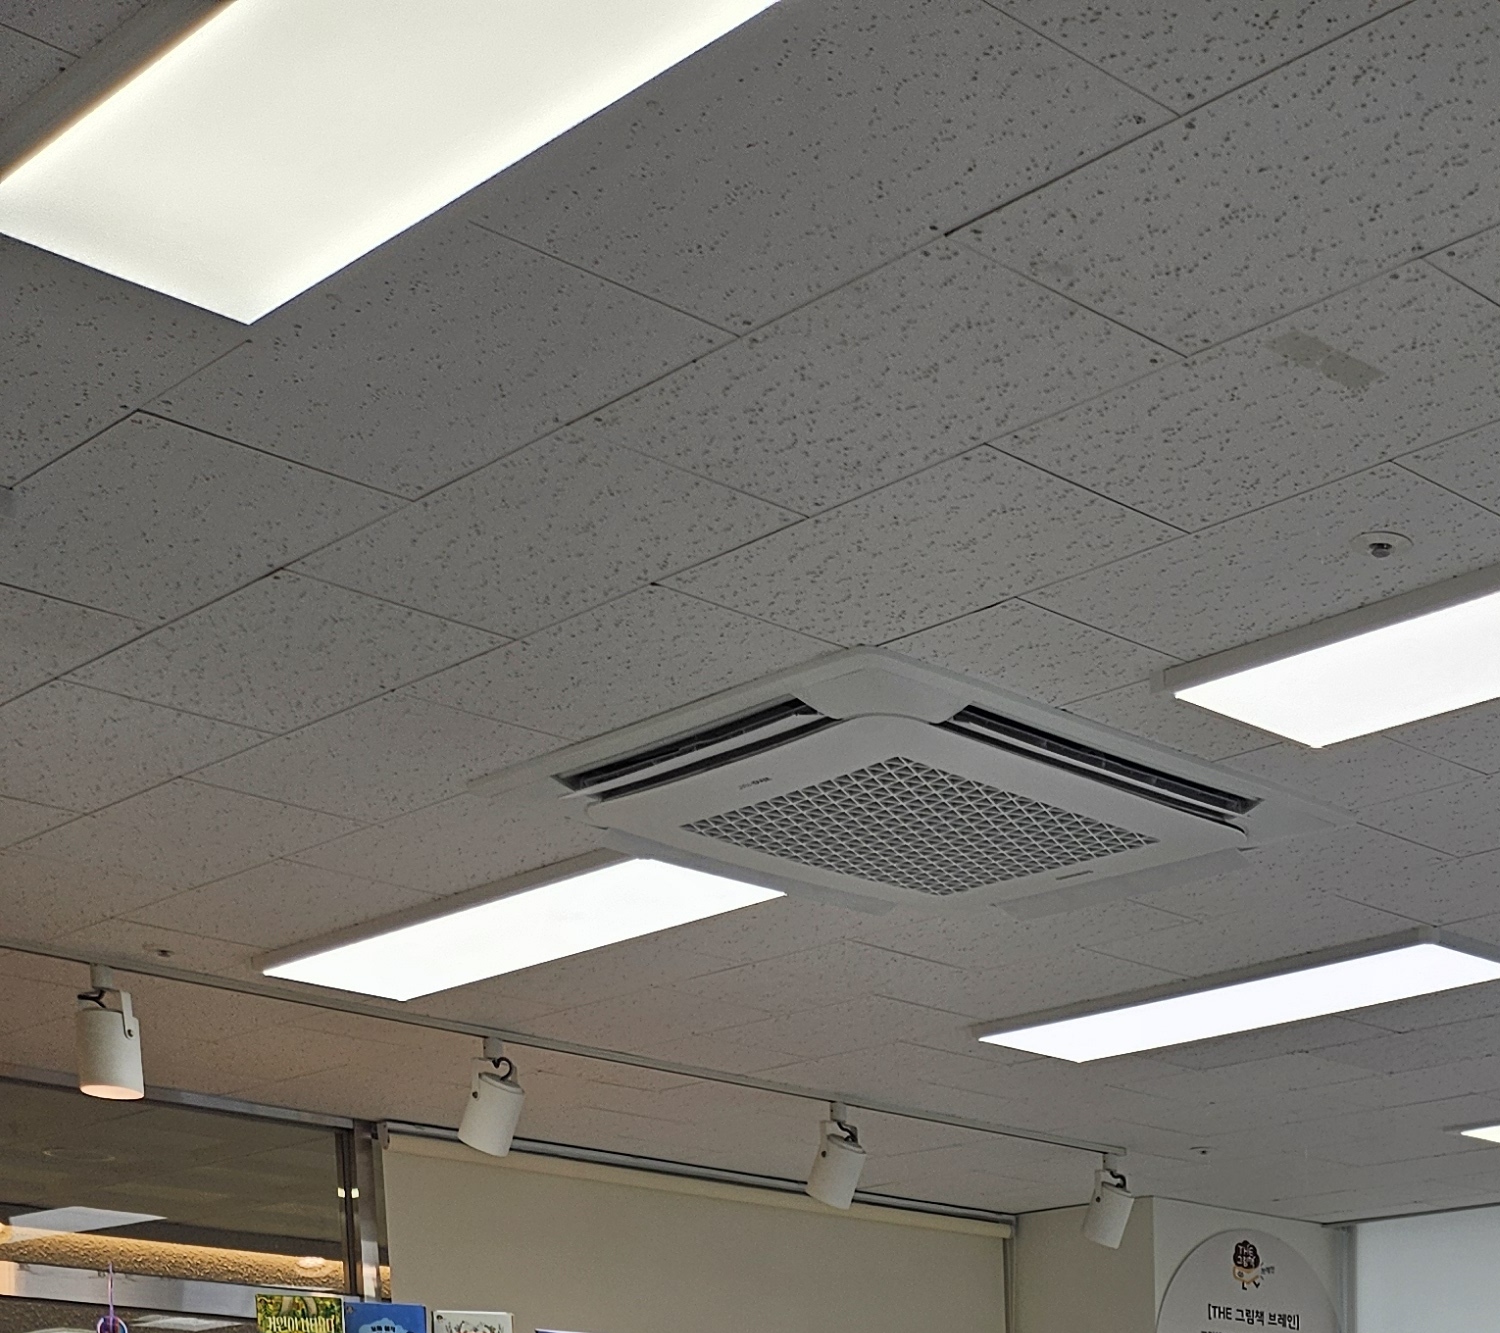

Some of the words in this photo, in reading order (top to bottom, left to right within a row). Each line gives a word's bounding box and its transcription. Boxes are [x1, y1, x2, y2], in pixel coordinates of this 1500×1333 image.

[1208, 1303, 1232, 1321] [THE
[1235, 1308, 1265, 1326] 그림책
[1268, 1313, 1300, 1331] 브레인]
